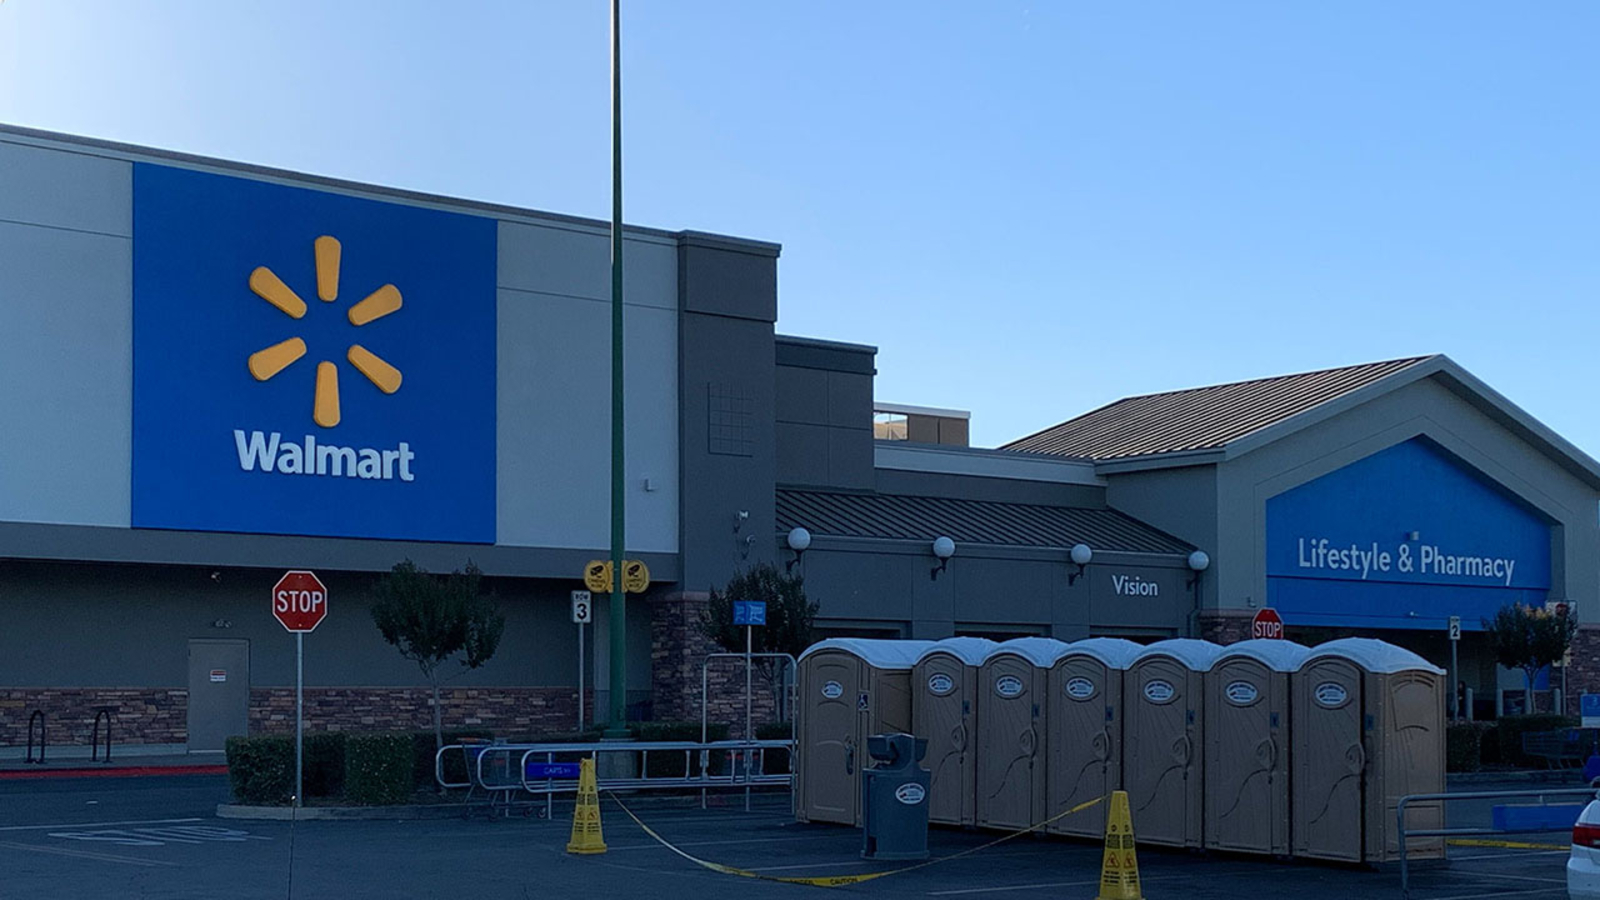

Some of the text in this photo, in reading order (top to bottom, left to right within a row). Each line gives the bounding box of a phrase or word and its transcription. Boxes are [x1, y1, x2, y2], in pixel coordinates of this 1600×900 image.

[234, 430, 415, 481] Walmart
[1298, 538, 1515, 586] Lifestyle & Pharmacy
[1112, 575, 1158, 596] Vision
[277, 590, 323, 612] STOP
[576, 603, 587, 620] 3
[1254, 621, 1282, 637] STOP
[1451, 624, 1459, 637] 2
